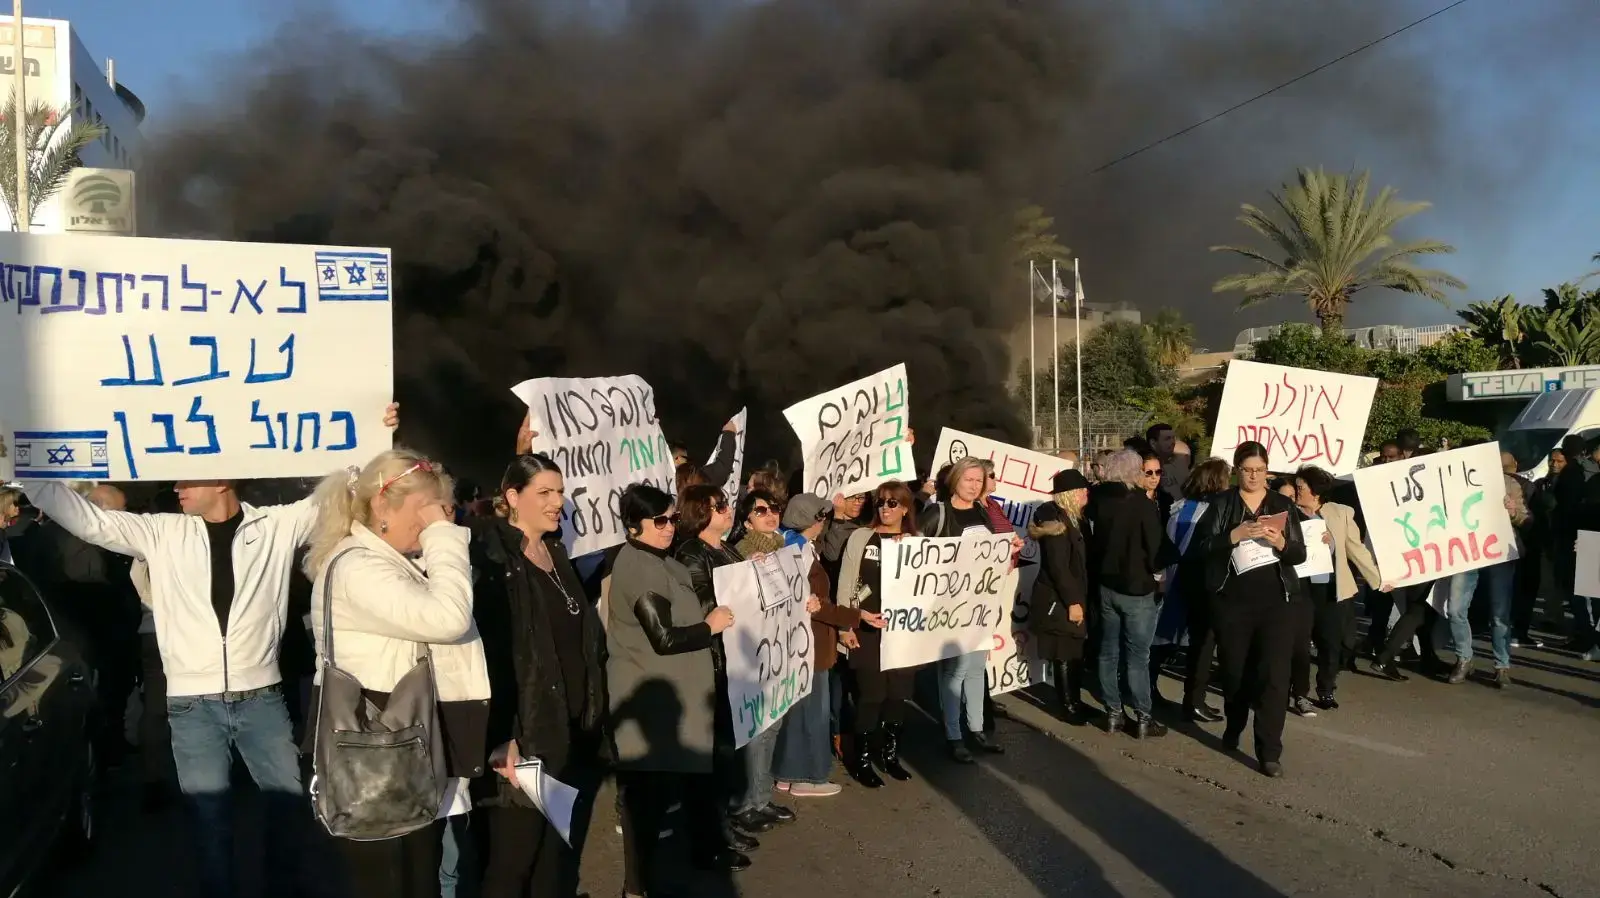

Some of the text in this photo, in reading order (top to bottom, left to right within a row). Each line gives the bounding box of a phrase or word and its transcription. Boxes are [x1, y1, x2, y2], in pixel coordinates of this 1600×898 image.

[100, 333, 295, 386] טבע
[1256, 372, 1344, 431] אין לנו
[1463, 373, 1543, 397] TEVA
[1549, 382, 1558, 391] 8
[113, 395, 357, 479] כחול לבן
[1288, 423, 1344, 466] טבע
[538, 440, 613, 479] וחמורי
[1390, 460, 1483, 520] אין לנו
[1393, 490, 1484, 548] טבע
[895, 538, 1011, 579] ביבי וכחלון
[913, 566, 1001, 598] אל תשכחו
[928, 601, 968, 632] טבע
